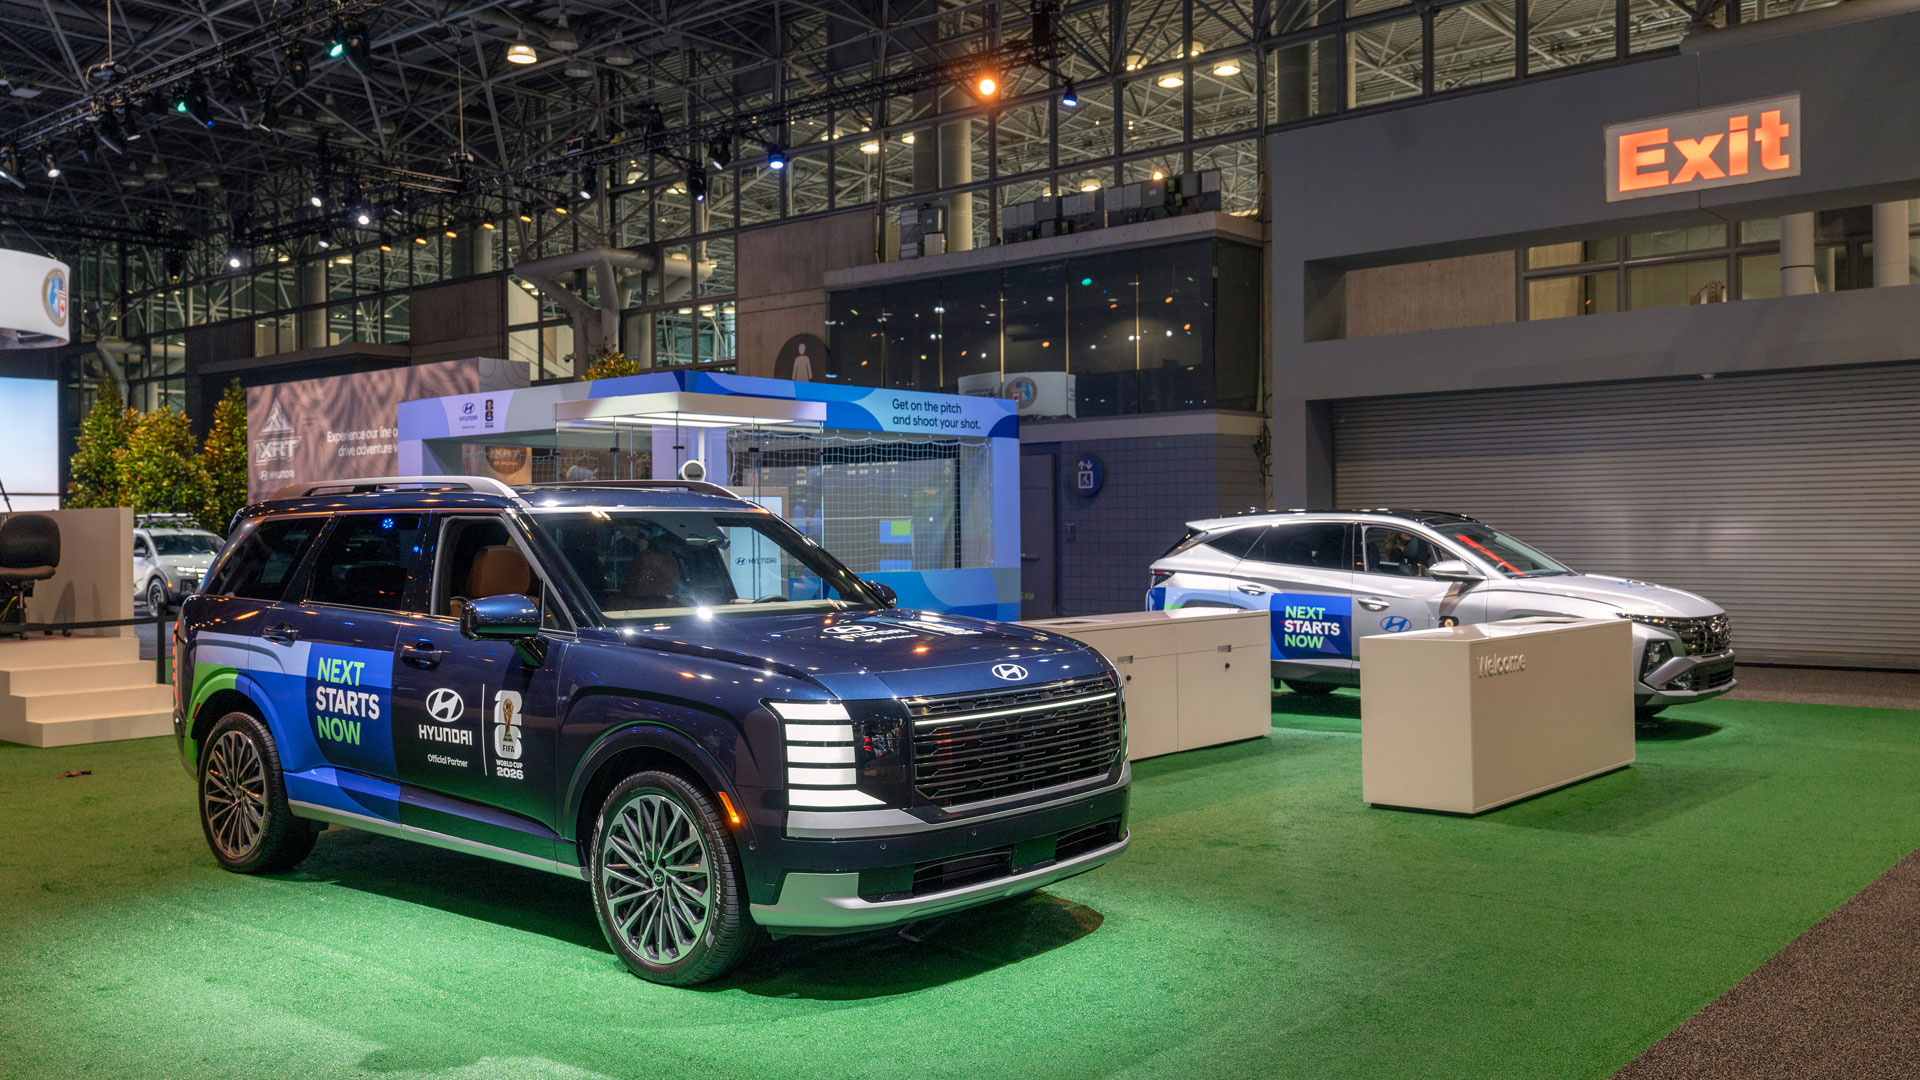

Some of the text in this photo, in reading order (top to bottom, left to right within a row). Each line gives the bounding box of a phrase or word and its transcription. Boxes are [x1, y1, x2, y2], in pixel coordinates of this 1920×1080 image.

[1618, 109, 1790, 192] Exit
[892, 398, 962, 415] Get on the pitch
[892, 414, 981, 430] and shoot your shot.
[327, 430, 366, 443] Experience
[366, 429, 378, 439] our
[379, 426, 392, 438] line
[256, 440, 298, 460] XRT
[338, 444, 356, 457] drive
[356, 443, 393, 456] adventure
[1285, 605, 1326, 620] NEXT
[1284, 619, 1340, 636] STARTS
[1284, 634, 1324, 649] NOW
[317, 657, 365, 686] NEXT
[1475, 653, 1526, 678] Welcome
[315, 686, 380, 720] STARTS
[317, 715, 361, 745] NOW
[418, 724, 473, 746] HYUNDAI
[502, 744, 515, 754] FIFA
[427, 754, 469, 768] Official Partner
[495, 759, 523, 769] WORLD CUP
[496, 766, 525, 780] 2026
[705, 833, 721, 905] SCORPION
